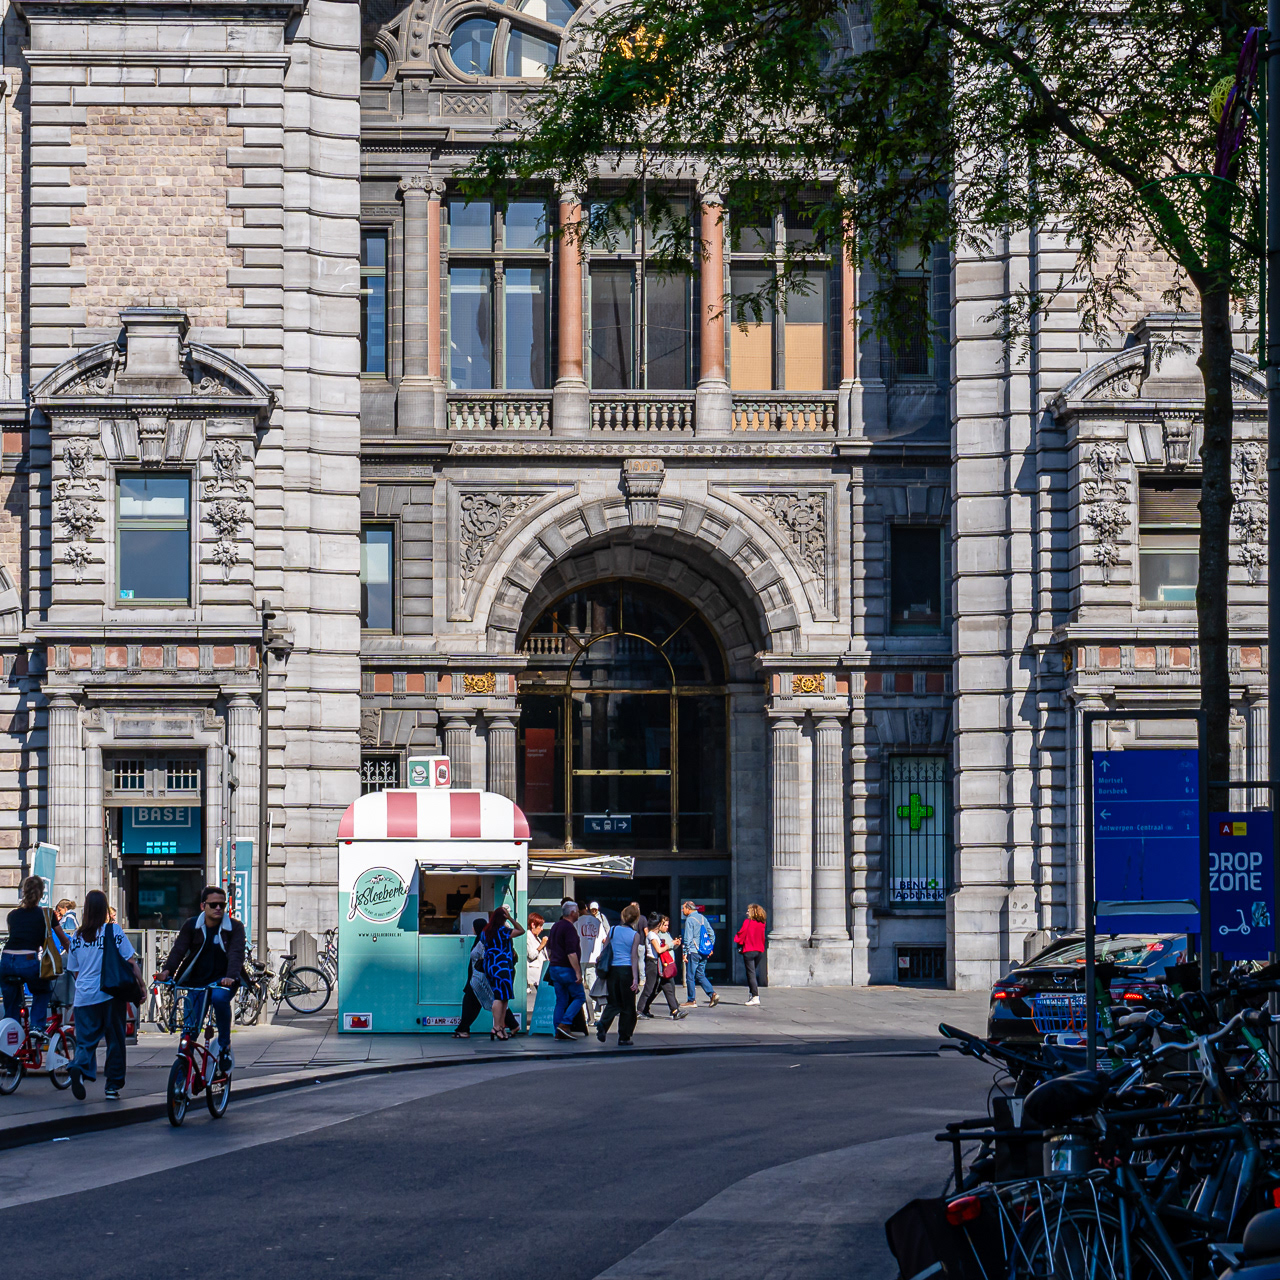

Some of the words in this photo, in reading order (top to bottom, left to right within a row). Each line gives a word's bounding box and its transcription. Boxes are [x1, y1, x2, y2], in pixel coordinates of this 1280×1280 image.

[628, 460, 659, 472] 1905
[138, 808, 185, 821] BASE
[1209, 852, 1263, 871] DROP
[899, 881, 928, 890] BENU
[1209, 872, 1263, 892] ZONE
[895, 891, 943, 900] Apotheek
